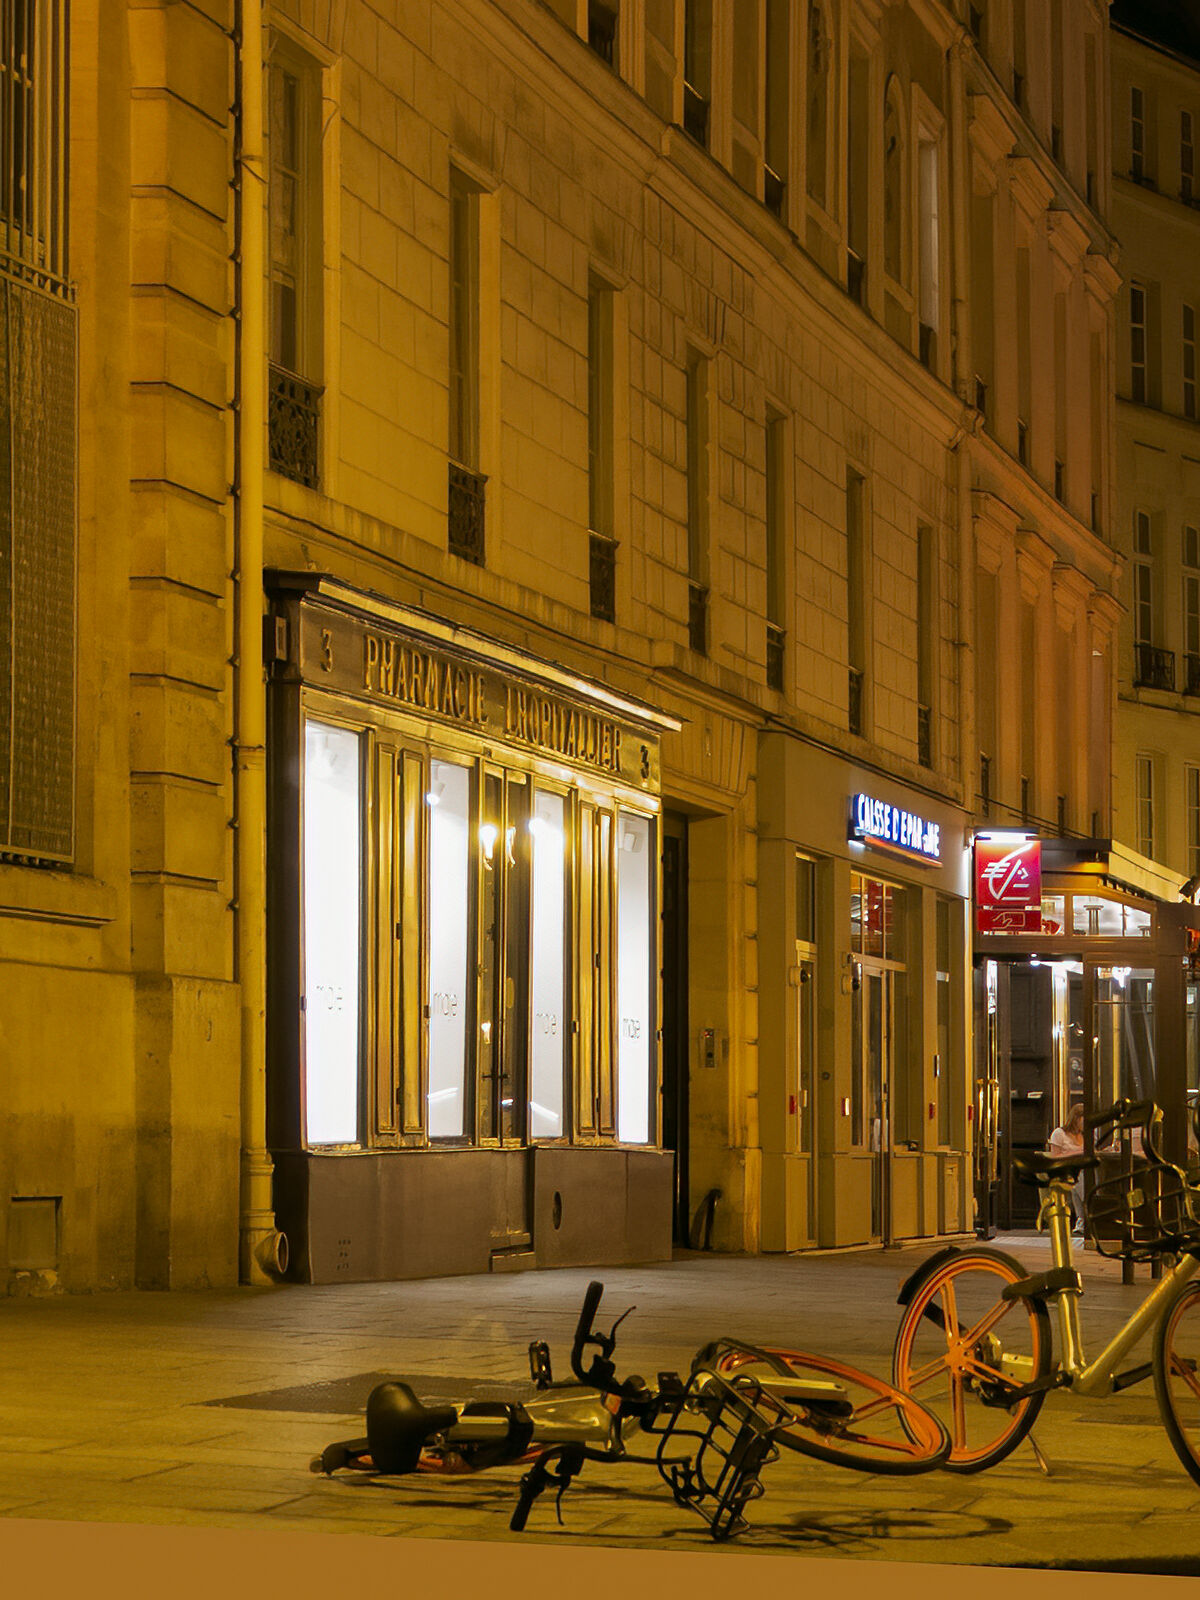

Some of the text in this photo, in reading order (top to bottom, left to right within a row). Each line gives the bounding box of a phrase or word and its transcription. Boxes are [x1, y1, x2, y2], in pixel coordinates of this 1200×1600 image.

[320, 628, 334, 673] 3
[364, 634, 489, 724] PHARMACIE
[639, 744, 650, 779] 3
[858, 793, 891, 839] CAISSE
